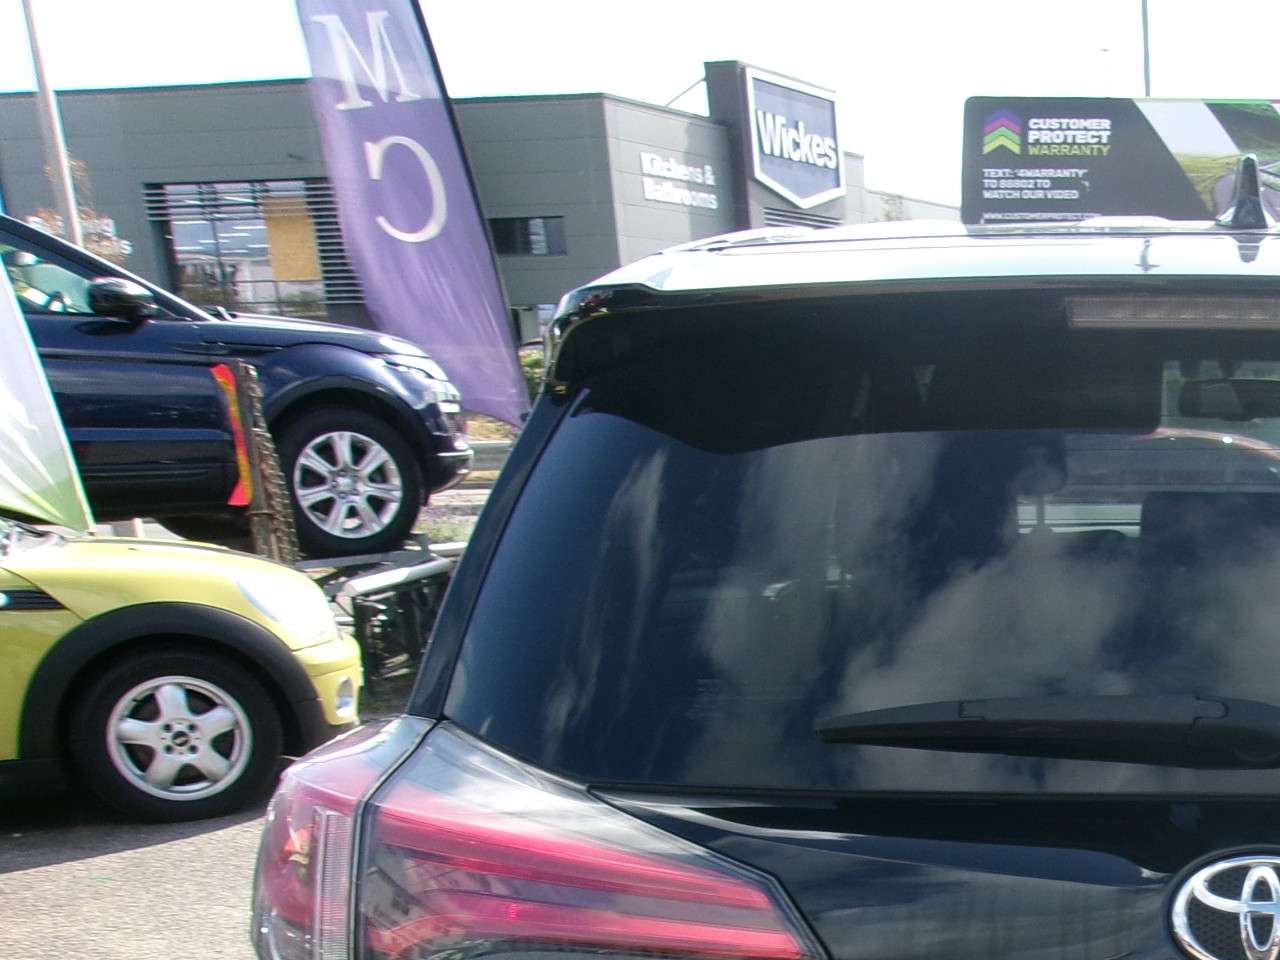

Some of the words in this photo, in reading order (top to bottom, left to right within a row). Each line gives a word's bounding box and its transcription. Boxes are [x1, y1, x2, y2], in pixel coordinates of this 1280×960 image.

[1028, 118, 1112, 130] CUSTOMER
[756, 110, 837, 169] Wickes
[1028, 130, 1112, 144] PROTECT
[1028, 144, 1112, 156] WARRANTY
[982, 179, 998, 189] TO
[1036, 179, 1052, 189] TO
[982, 189, 1020, 199] WATCH
[1021, 189, 1045, 199] OUR
[1045, 189, 1080, 199] VIDEO
